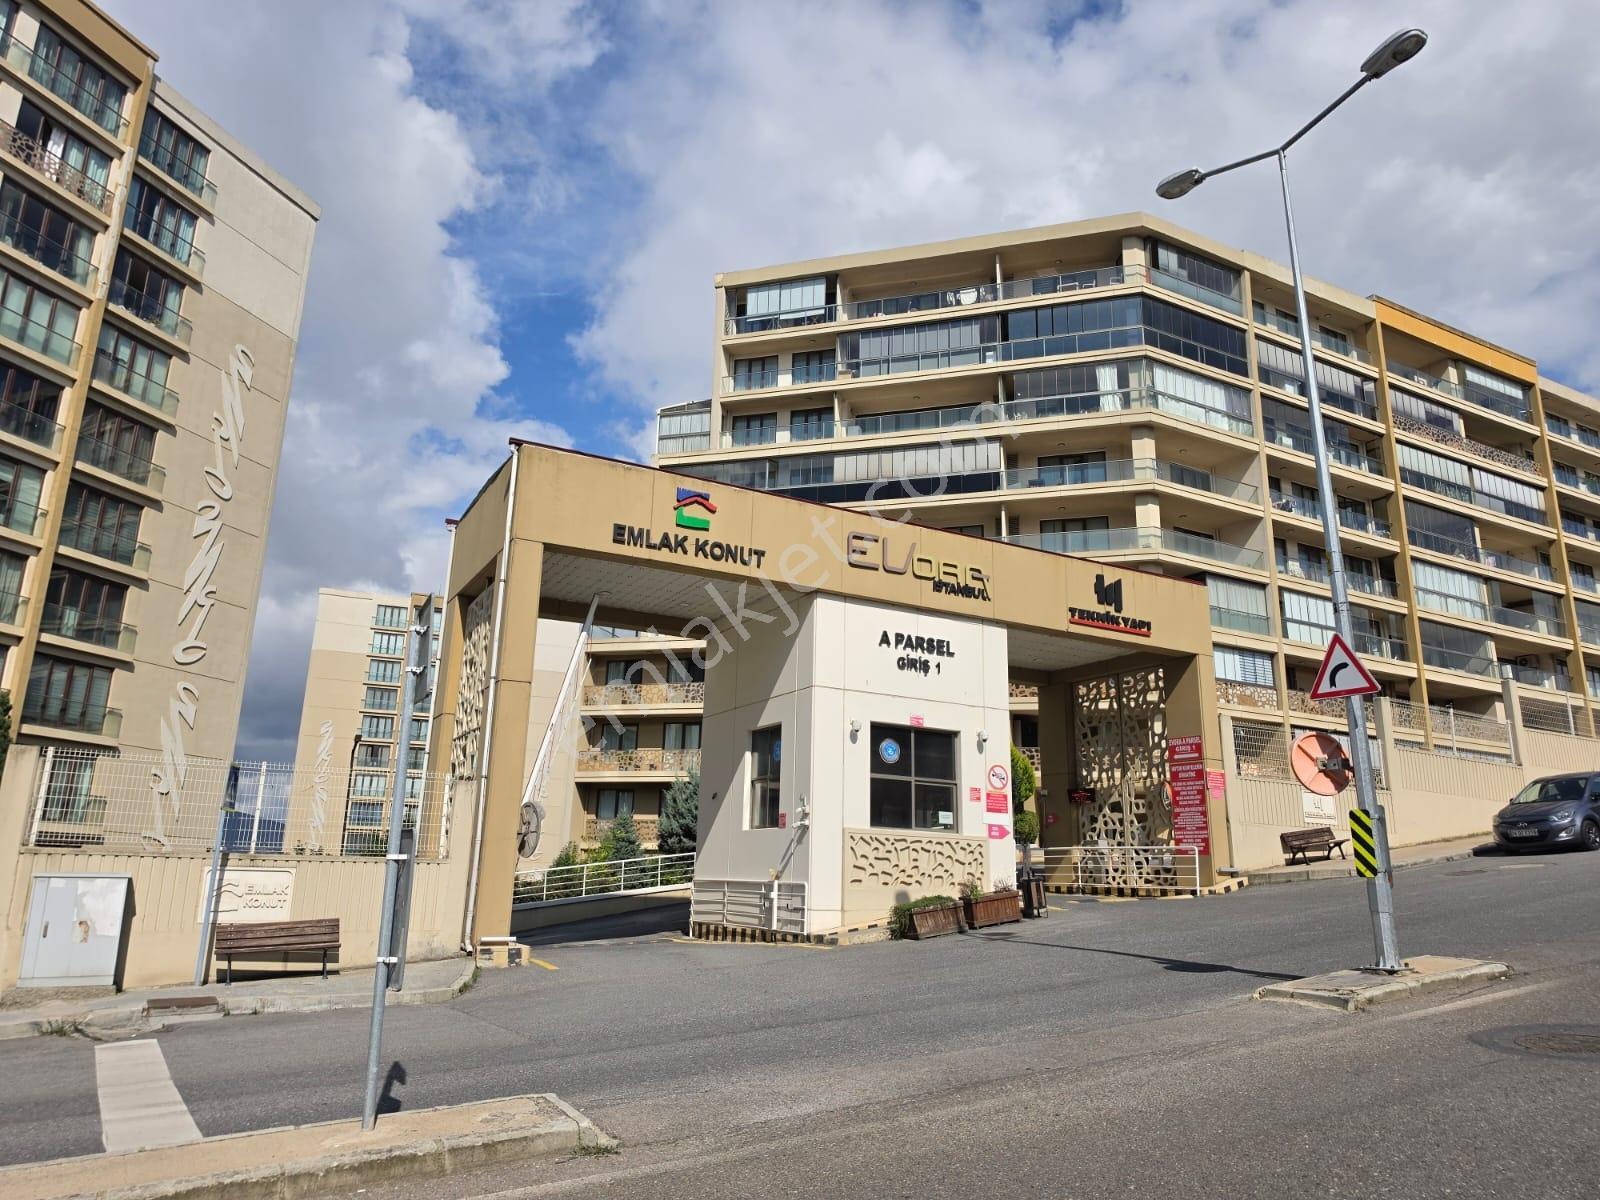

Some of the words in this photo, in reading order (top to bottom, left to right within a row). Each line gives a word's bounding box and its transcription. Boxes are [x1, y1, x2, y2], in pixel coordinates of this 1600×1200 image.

[612, 522, 689, 555] EMLAK
[694, 537, 767, 569] KONUT
[1121, 616, 1152, 631] YAPI
[878, 630, 891, 648] A
[894, 632, 955, 658] PARSEL
[896, 654, 931, 677] GİRİŞ
[935, 661, 941, 675] 1
[245, 885, 290, 895] EMLAK
[243, 898, 287, 908] KONUT
